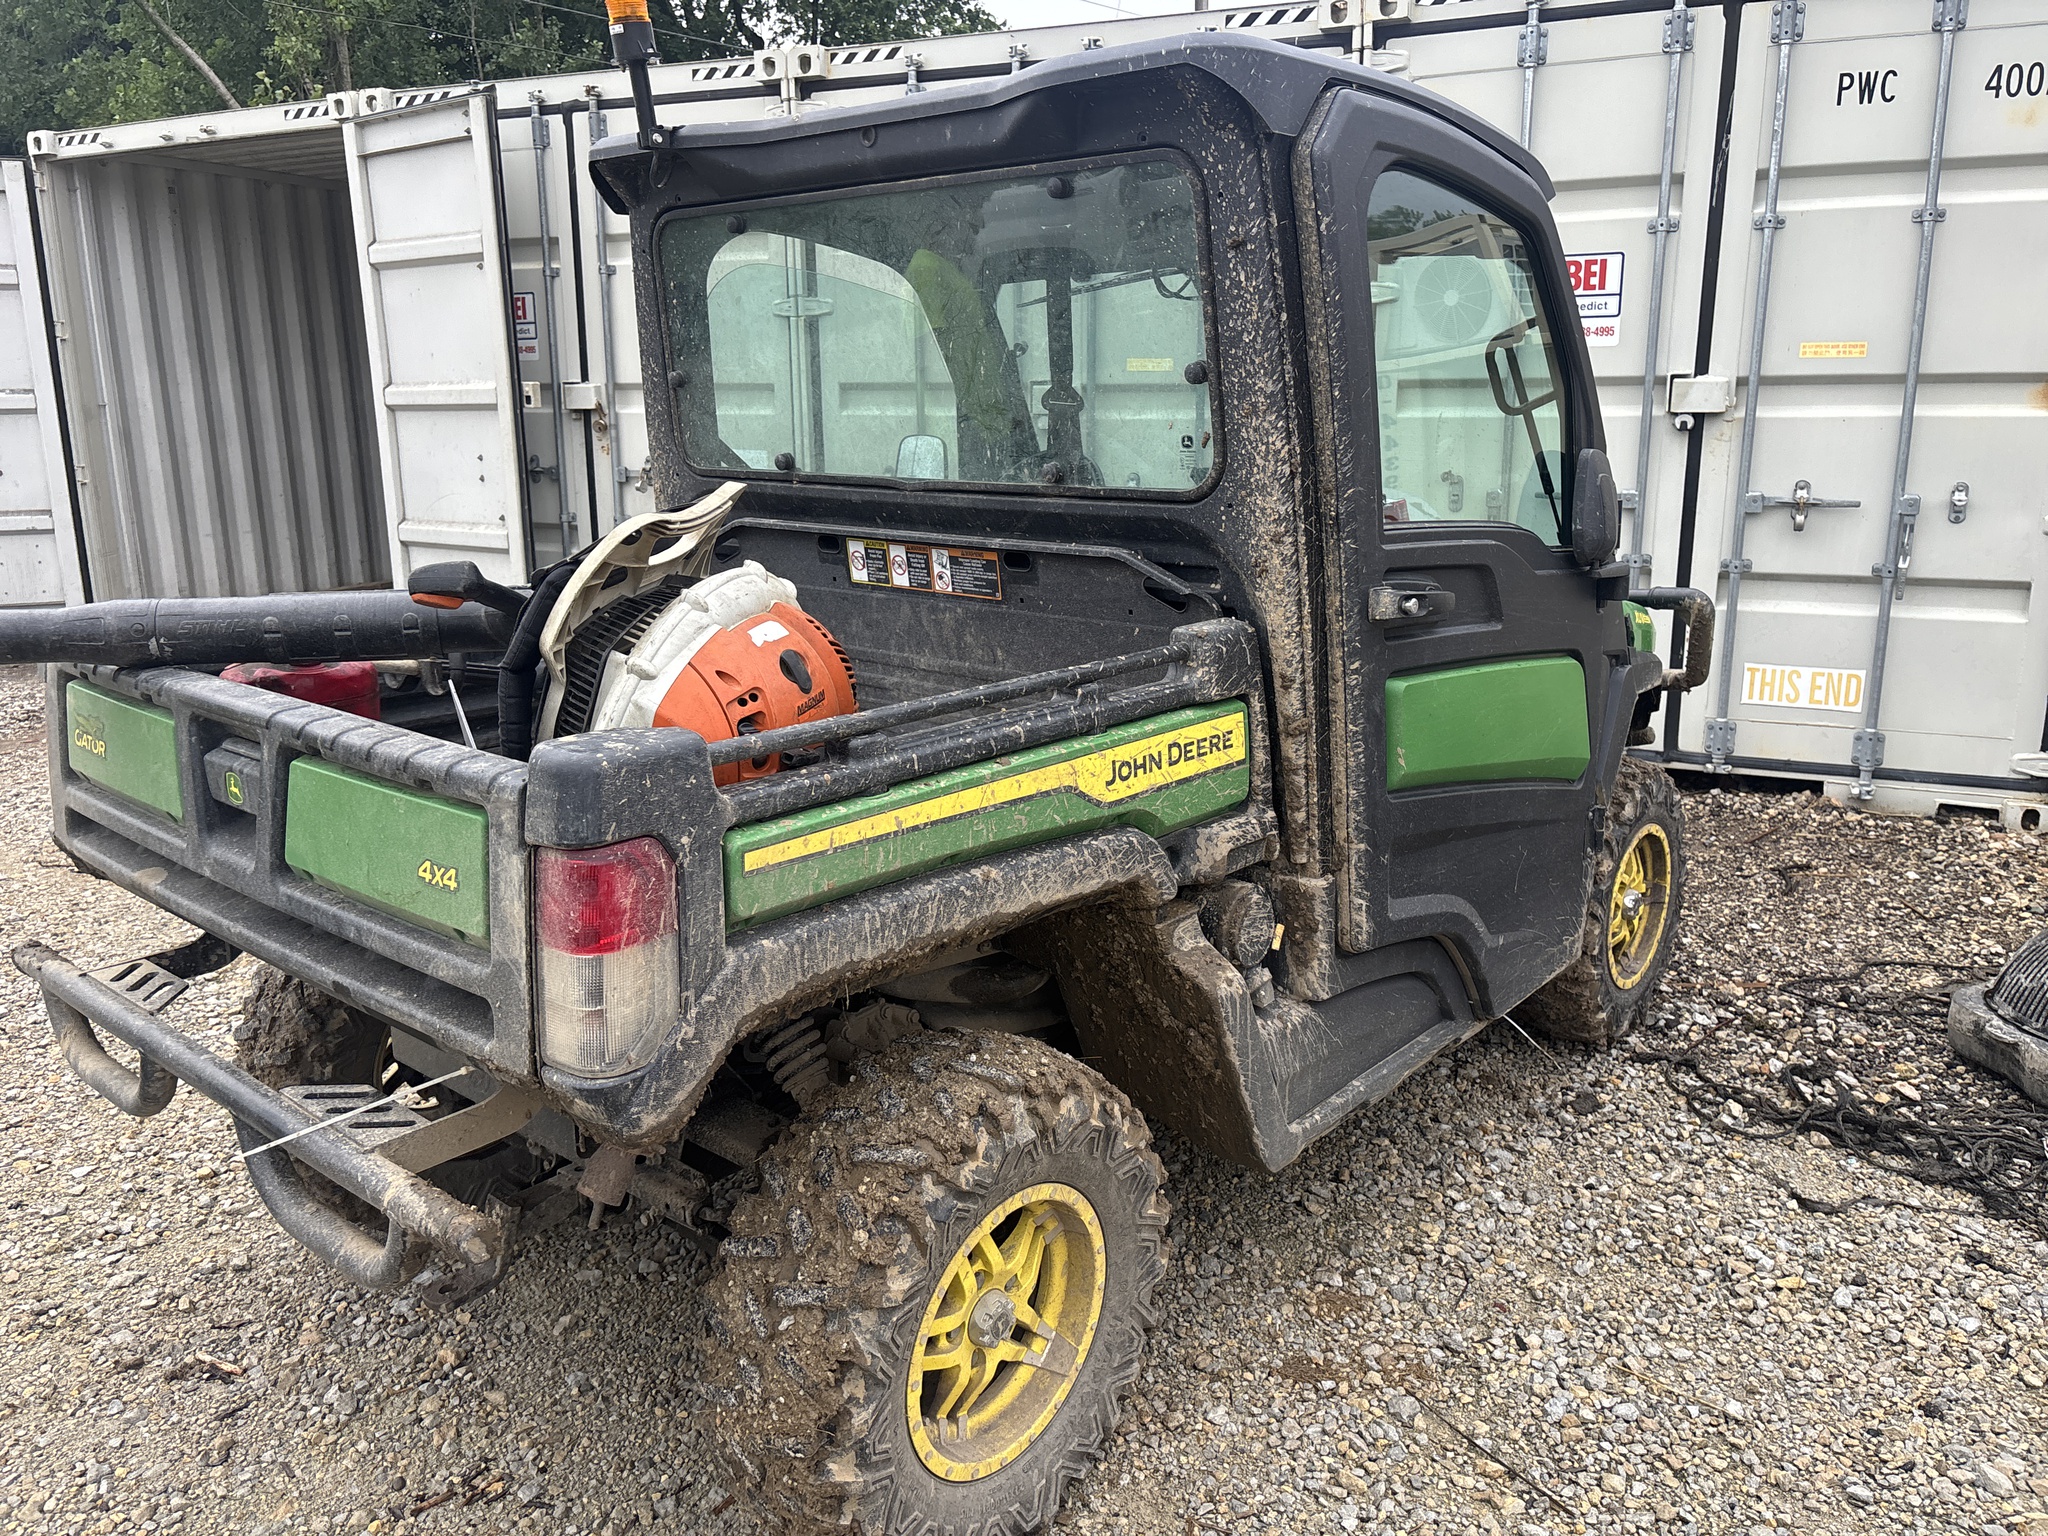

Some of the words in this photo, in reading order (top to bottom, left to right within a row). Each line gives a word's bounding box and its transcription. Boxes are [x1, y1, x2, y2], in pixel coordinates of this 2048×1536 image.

[1836, 69, 1898, 106] PWC
[1984, 61, 2048, 98] 400
[514, 296, 527, 320] EI
[1577, 301, 1608, 311] edict
[1746, 667, 1802, 704] THIS
[1808, 671, 1863, 707] END
[797, 689, 826, 716] MAGNUM
[74, 728, 106, 758] GATOR
[1105, 750, 1163, 789] JOHN
[1167, 729, 1234, 768] DEERE
